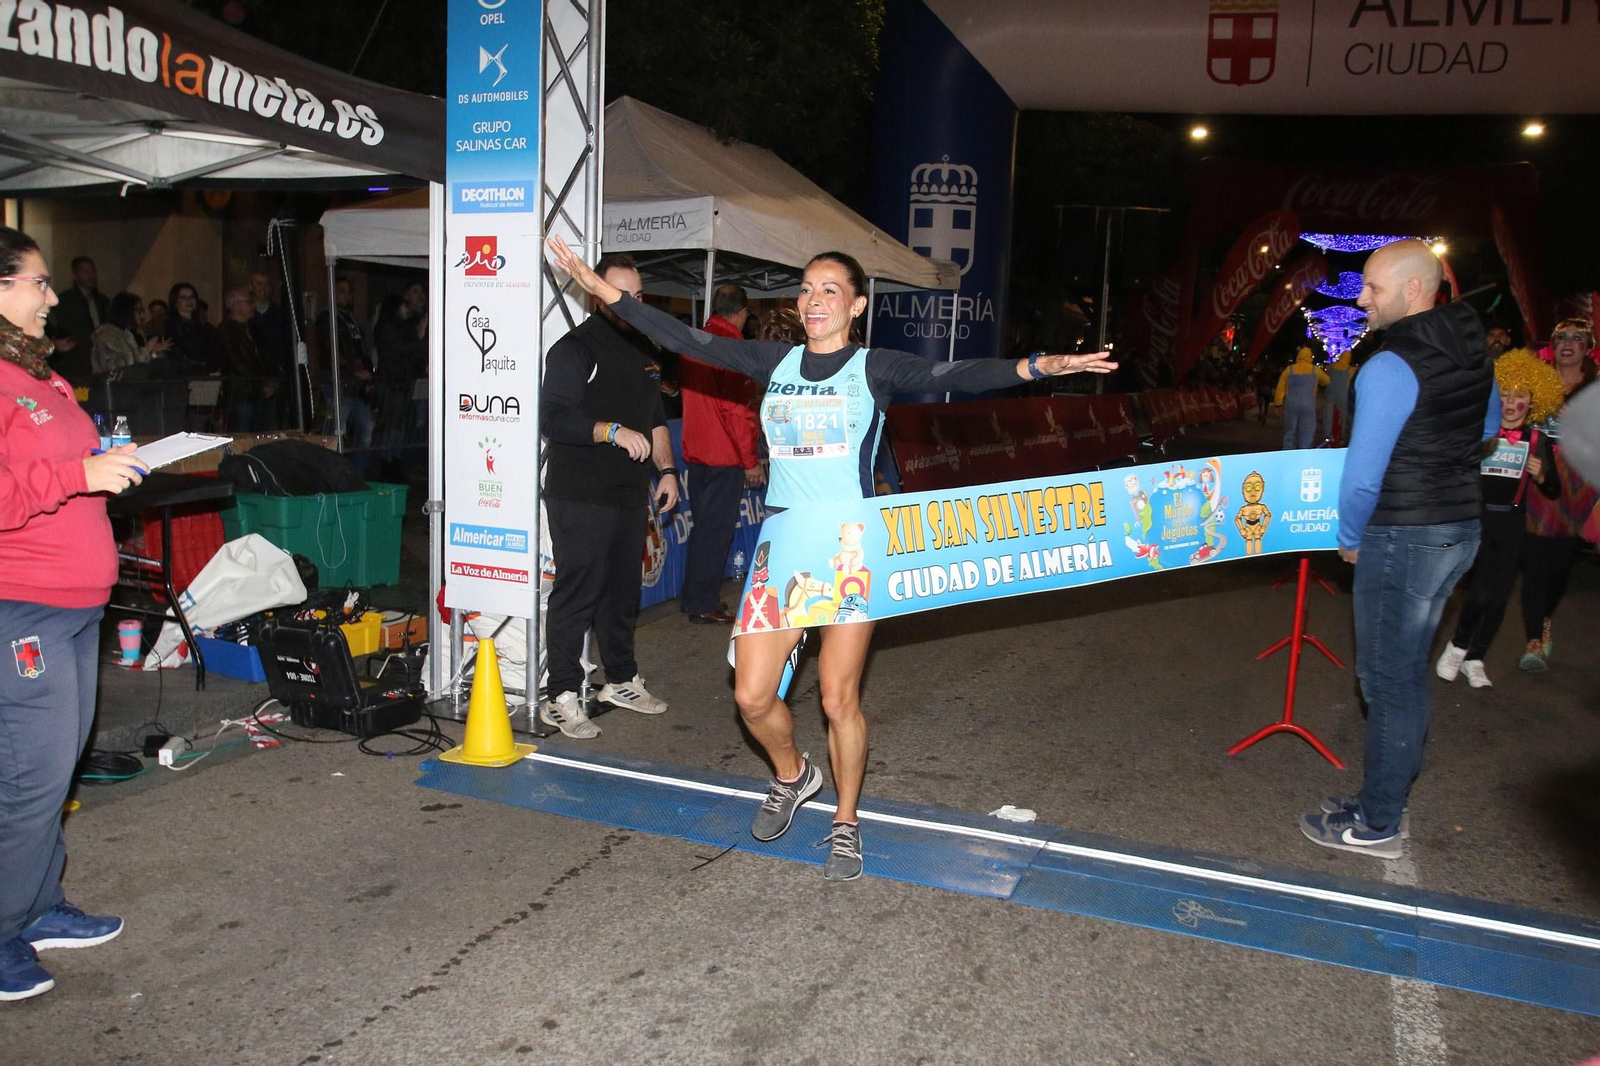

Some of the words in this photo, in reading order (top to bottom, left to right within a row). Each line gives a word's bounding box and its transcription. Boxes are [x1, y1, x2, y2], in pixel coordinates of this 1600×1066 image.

[479, 12, 506, 26] OPEL
[1344, 41, 1509, 76] CIUDAD
[458, 94, 469, 105] DS
[471, 90, 529, 104] AUTOMOBILES
[472, 120, 511, 134] GRUPO
[456, 139, 501, 152] SALINAS
[503, 137, 527, 150] CAR
[461, 187, 525, 202] DECATHLON
[616, 211, 687, 232] ALMERÍA
[615, 232, 652, 244] CIUDAD
[877, 291, 995, 323] ALMERÍA
[903, 322, 971, 340] CIUDAD
[459, 394, 520, 415] DUNA
[459, 413, 520, 423] reformasduna.com
[794, 412, 839, 431] 1821
[1491, 451, 1523, 464] 2483
[478, 483, 503, 493] BUEN
[880, 504, 926, 556] XII
[927, 498, 978, 550] SAN
[977, 481, 1107, 543] SILVESTRE
[1280, 506, 1339, 522] ALMERÍA
[1289, 523, 1331, 534] CIUDAD
[453, 527, 505, 547] Almericar
[451, 564, 462, 574] La
[463, 565, 480, 576] Voz
[480, 568, 491, 578] de
[492, 570, 528, 583] Almería
[887, 559, 980, 602] CIUDAD
[982, 554, 1015, 588] DE
[1018, 534, 1114, 582] ALMERÍA
